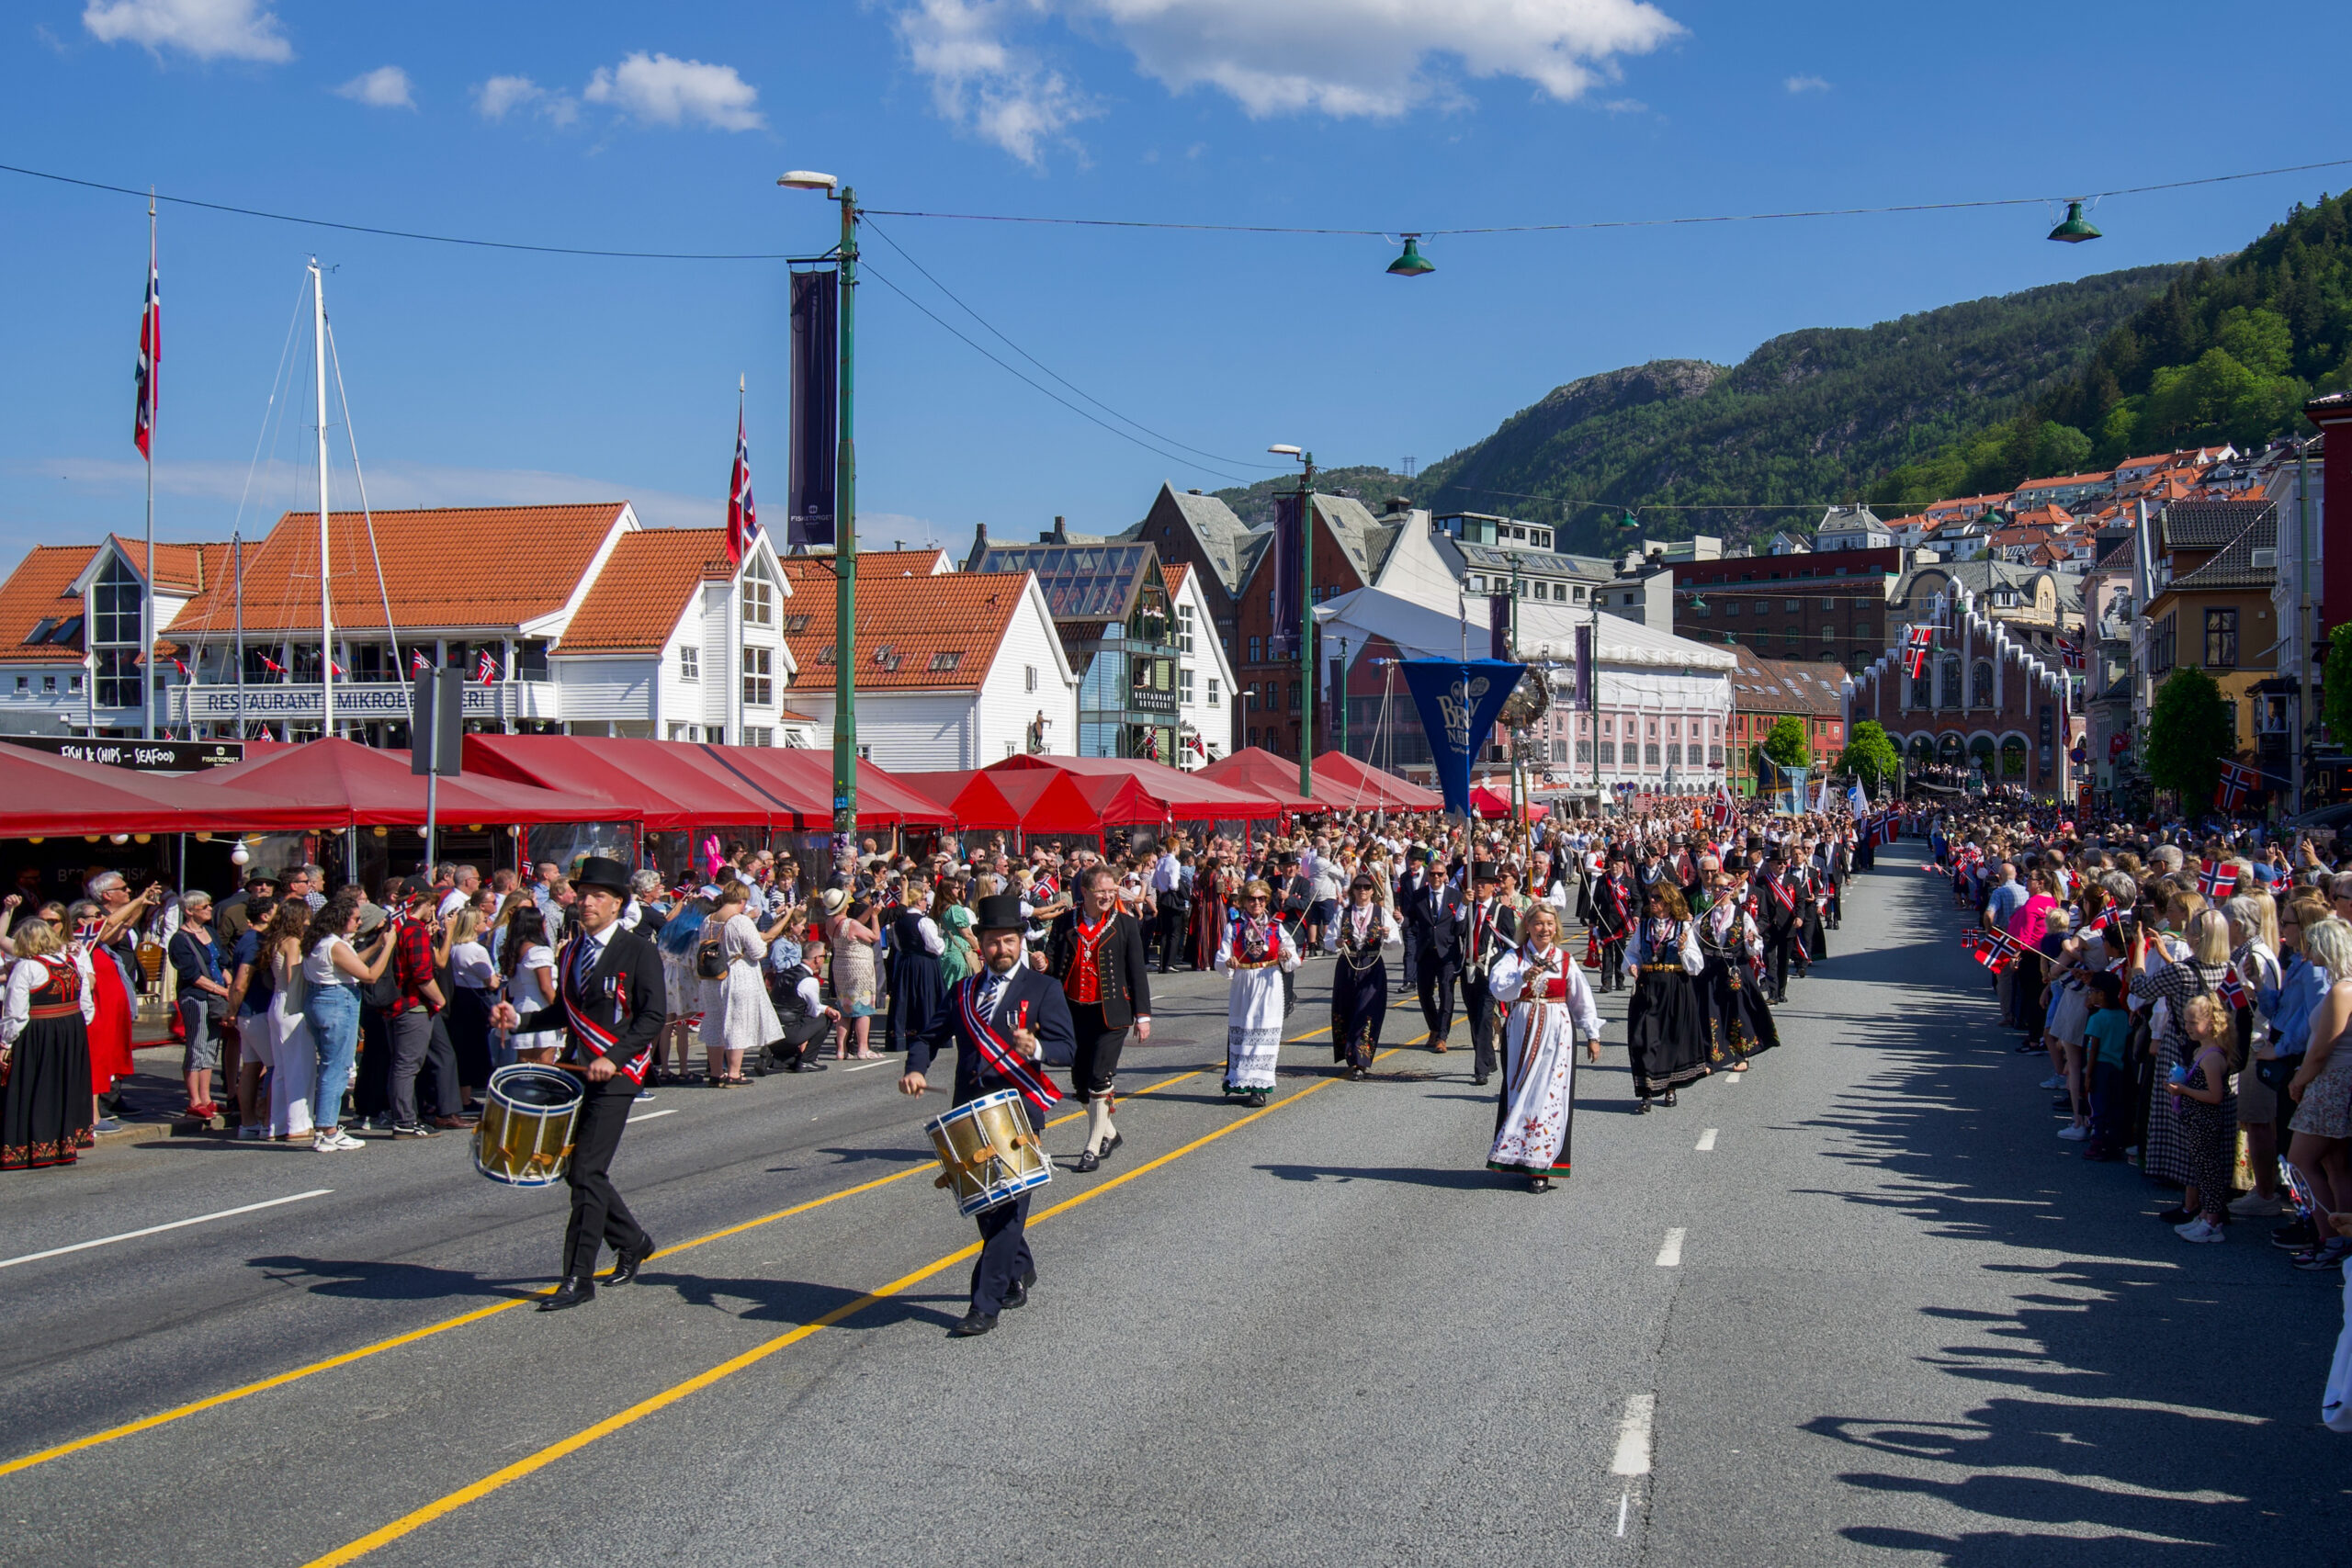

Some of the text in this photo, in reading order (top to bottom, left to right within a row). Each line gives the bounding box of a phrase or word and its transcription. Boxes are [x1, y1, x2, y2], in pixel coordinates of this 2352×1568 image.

[209, 693, 322, 710] RESTAURANT
[1135, 692, 1174, 702] RESTAURANT
[1139, 700, 1170, 708] BRYGGERI
[61, 745, 83, 761] FISH
[96, 746, 121, 764] CHIPS
[135, 747, 175, 765] SEAFOOD
